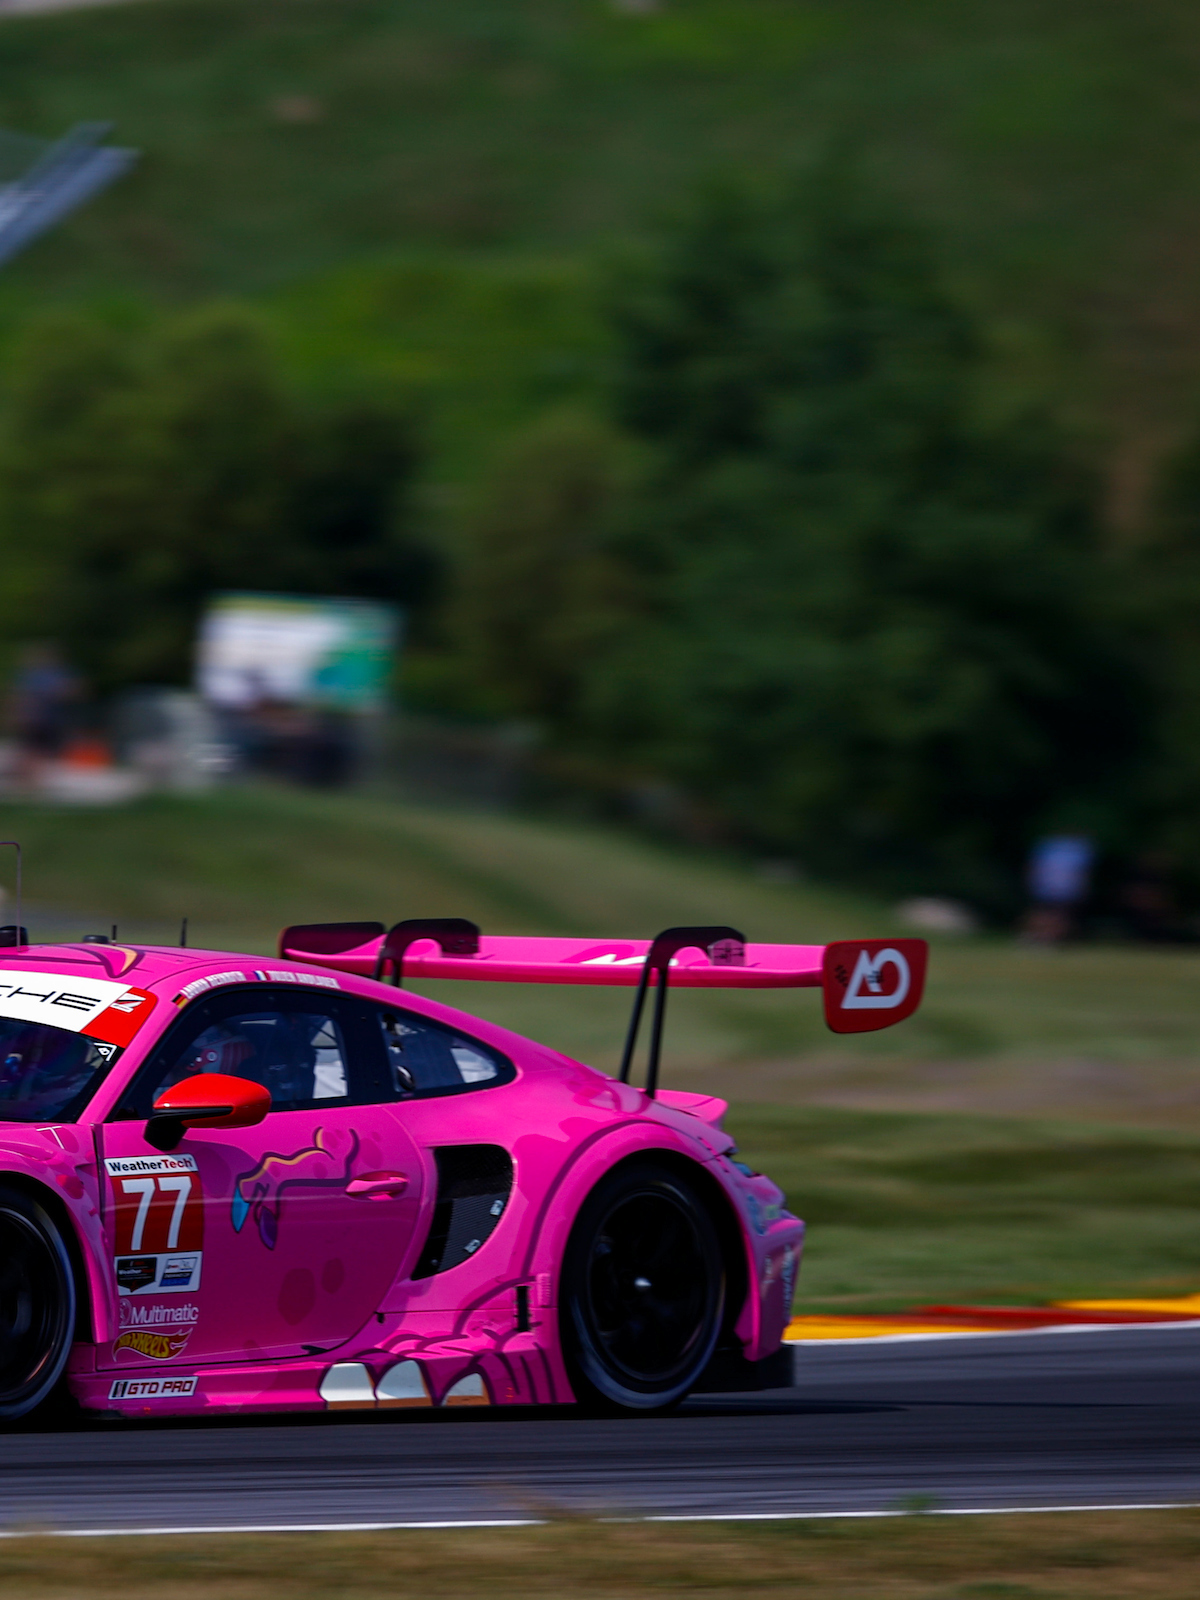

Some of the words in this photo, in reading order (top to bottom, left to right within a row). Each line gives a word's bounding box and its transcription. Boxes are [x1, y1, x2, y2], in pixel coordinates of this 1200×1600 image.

[109, 1158, 193, 1172] WeatherTech
[121, 1176, 192, 1251] 77
[131, 1303, 199, 1324] Multimatic
[127, 1382, 159, 1394] GTD
[161, 1380, 194, 1393] PRO
